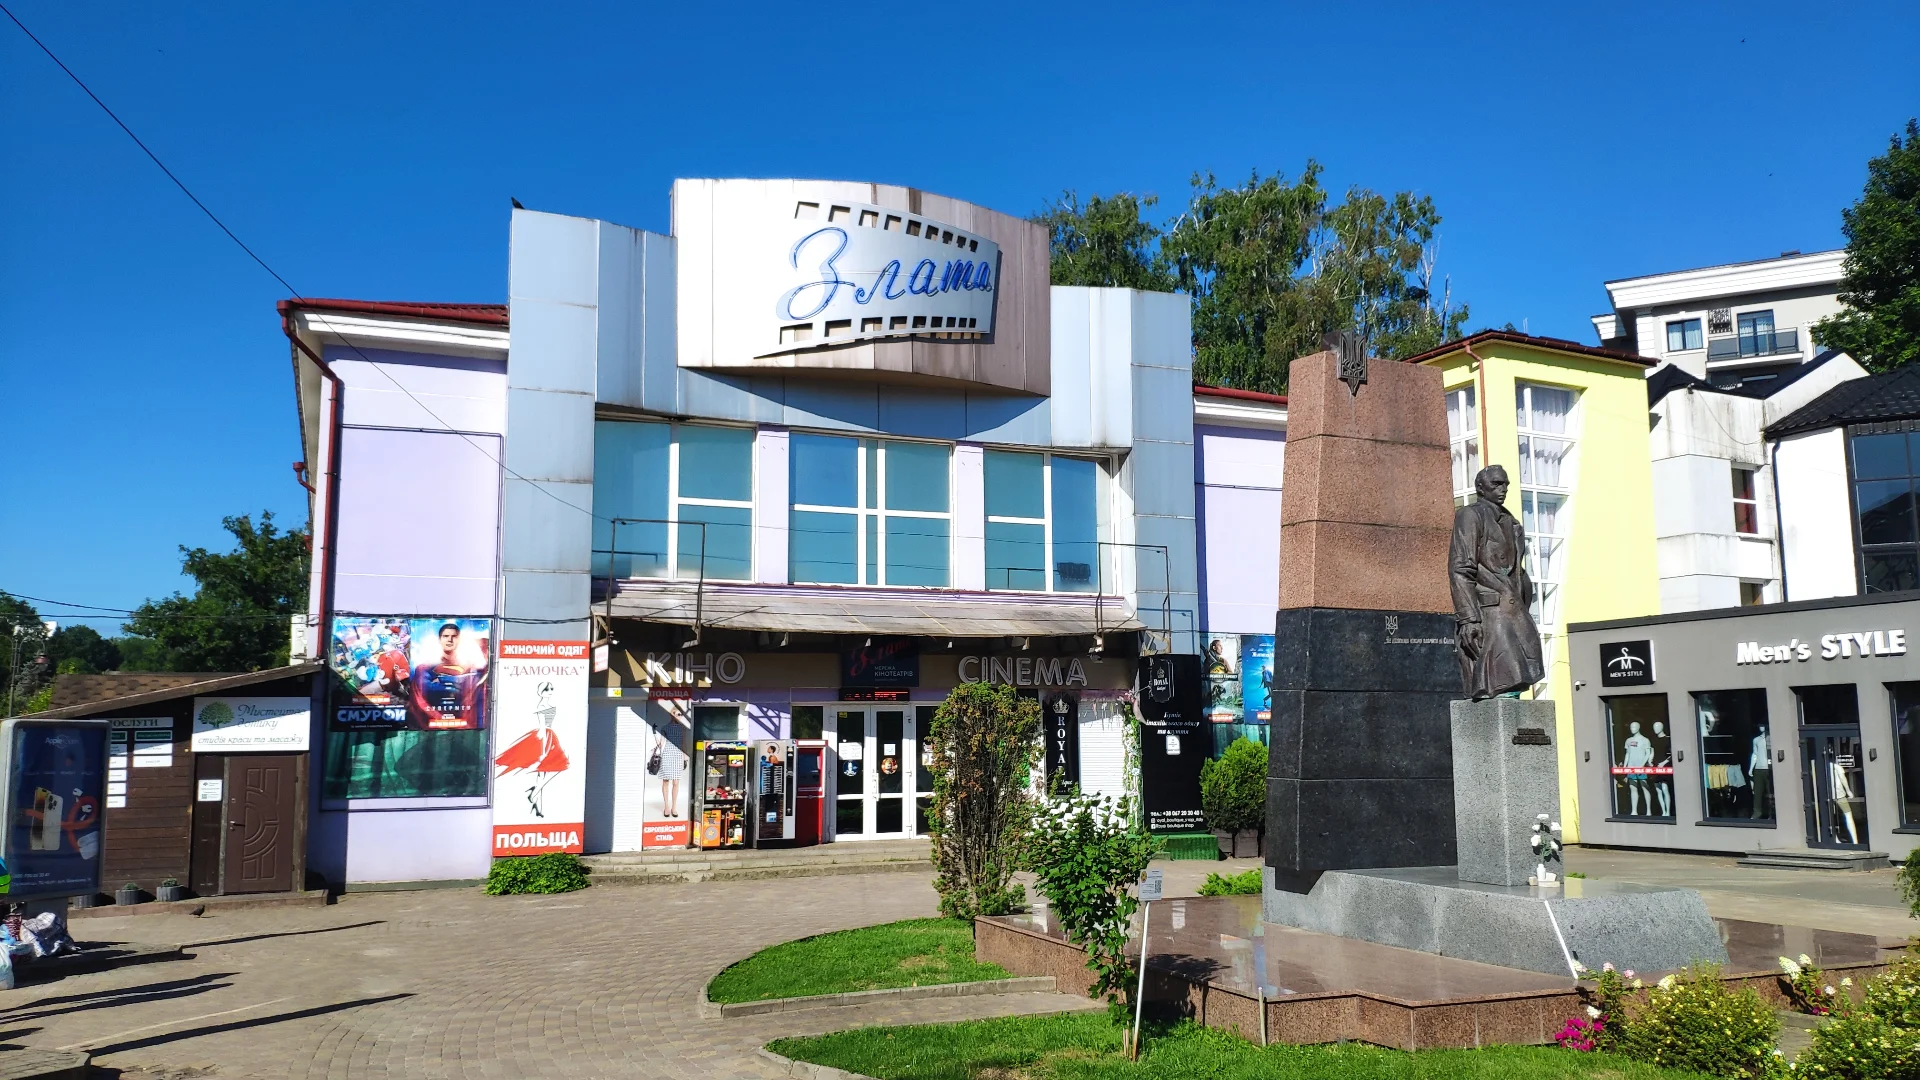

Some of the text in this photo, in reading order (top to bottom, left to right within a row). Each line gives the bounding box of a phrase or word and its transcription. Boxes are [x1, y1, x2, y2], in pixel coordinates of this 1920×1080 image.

[776, 226, 994, 321] Злата
[504, 644, 585, 656] ЖІНОЧИЙ ОДЯГ
[1736, 629, 1907, 666] Men's STYLE
[646, 652, 745, 684] КІНО
[958, 655, 1088, 687] CINEMA
[649, 690, 690, 698] ПОЛЬЩА
[110, 719, 159, 727] ОСЛУГИ
[644, 824, 686, 834] ЄВРОПЕЙСЬКИЙ
[496, 831, 580, 849] ПОЛЬЩА
[655, 834, 675, 842] СТИЛЬ
